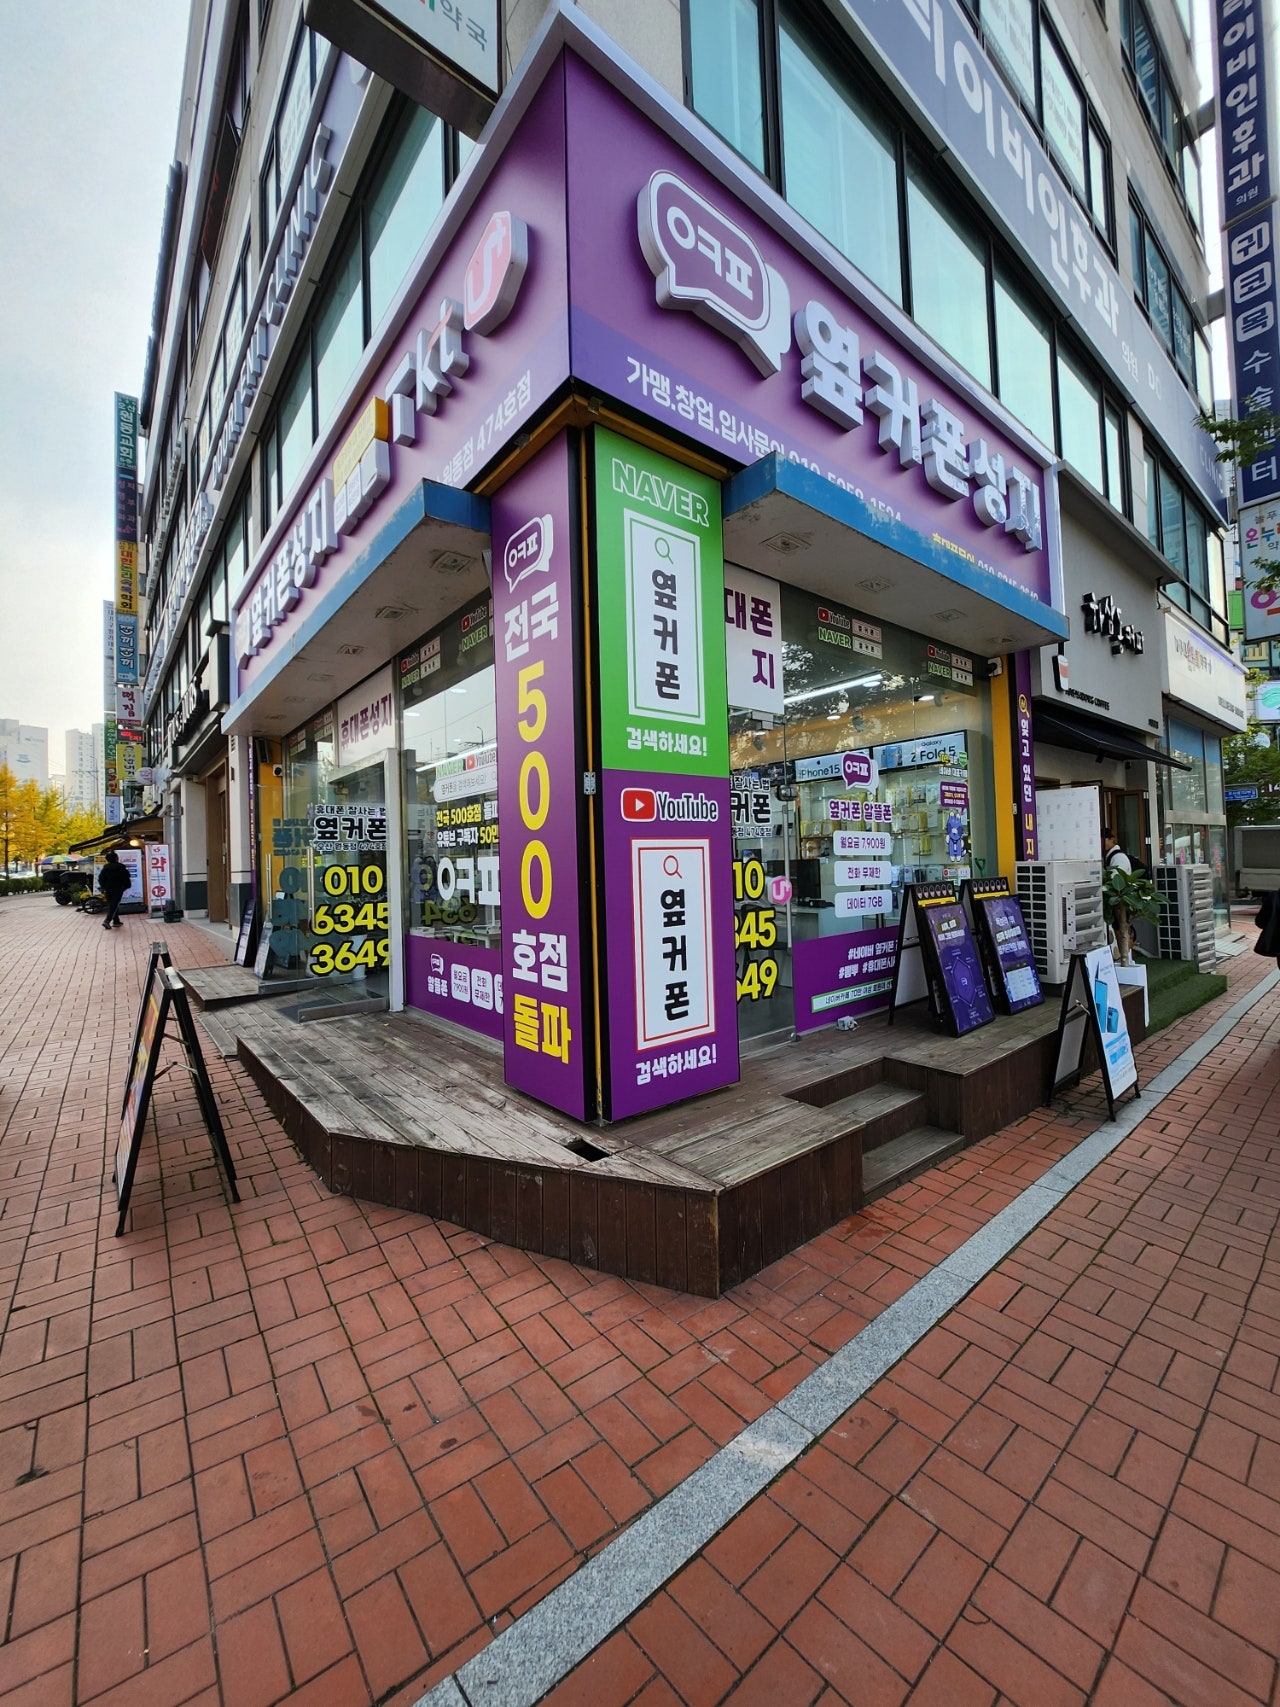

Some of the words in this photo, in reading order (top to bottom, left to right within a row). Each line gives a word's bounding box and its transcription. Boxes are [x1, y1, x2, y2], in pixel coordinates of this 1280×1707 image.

[266, 122, 333, 326] CLINIC
[477, 369, 530, 452] 474호점
[794, 300, 1042, 552] 옆커폰성지
[612, 457, 709, 526] NAVER
[251, 477, 338, 648] 옆커폰성지
[504, 581, 559, 663] 전국
[651, 569, 681, 700] 옆커폰
[818, 626, 852, 649] NAVER
[461, 624, 489, 653] NAVER
[927, 660, 951, 679] NAVER
[341, 692, 392, 750] 휴대폰성지
[626, 726, 708, 757] 검색하세요!
[315, 805, 346, 815] 휴대폰
[436, 809, 451, 827] 전국
[451, 804, 482, 825] 500호점
[657, 791, 719, 822] YouTube
[829, 799, 861, 820] 옆커폰
[863, 801, 893, 821] 알뜰폰
[314, 816, 387, 841] 옆커폰
[457, 826, 479, 846] 구독자
[840, 836, 860, 849] 월요금
[861, 837, 886, 850] 7,900원
[152, 857, 167, 872] 약
[847, 866, 861, 879] 전화
[862, 865, 881, 879] 무제한
[323, 864, 385, 898] 010
[311, 902, 390, 936] 6345
[846, 898, 866, 910] 데이터
[867, 896, 883, 908] 7GB
[311, 938, 390, 975] 3649
[511, 929, 568, 993] 호점
[660, 888, 690, 1021] 옆커폰
[427, 975, 448, 997] 알뜰폰
[513, 994, 572, 1064] 돌파
[635, 1043, 717, 1086] 검색하세요!
